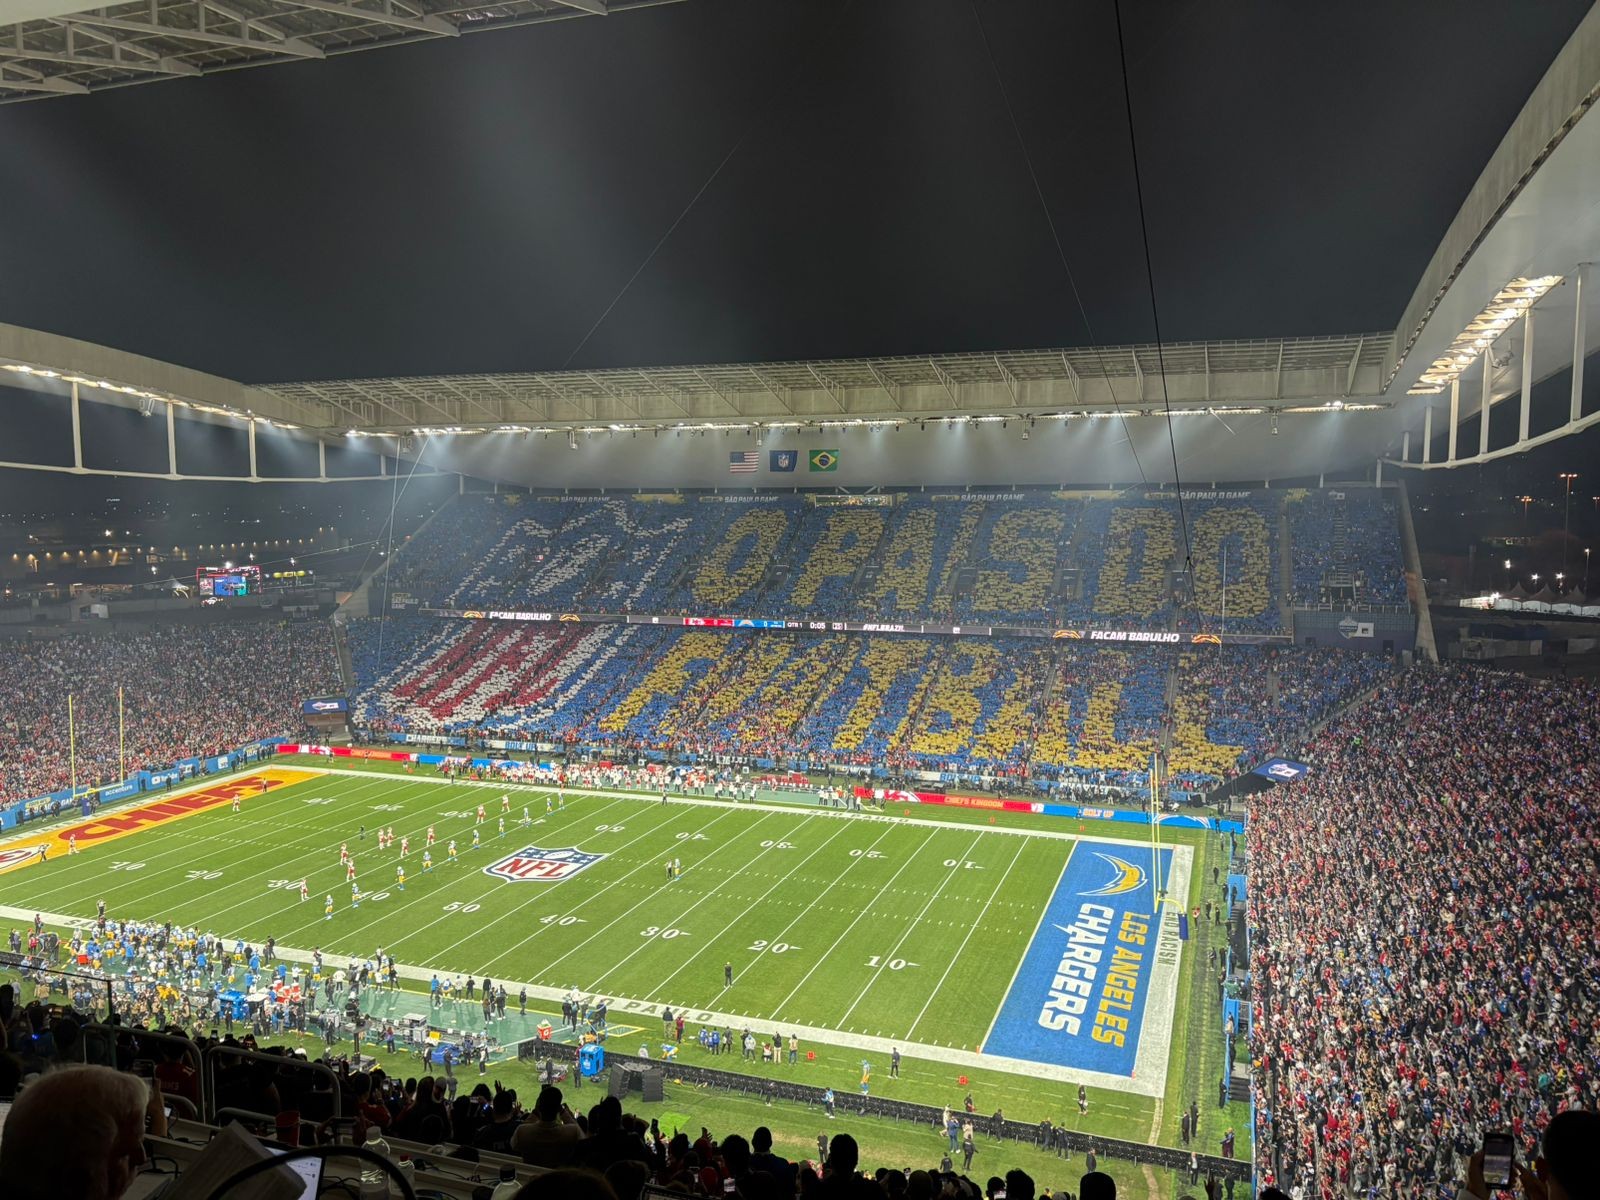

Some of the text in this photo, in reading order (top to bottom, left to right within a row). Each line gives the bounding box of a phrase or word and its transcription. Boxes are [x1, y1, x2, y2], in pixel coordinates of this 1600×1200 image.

[1128, 632, 1180, 642] BARULHO
[58, 776, 284, 841] CHIEFS
[971, 798, 1004, 807] KINGDOM
[500, 858, 567, 877] NFL
[442, 902, 480, 913] 50
[539, 915, 576, 926] 40
[640, 927, 682, 939] 30
[748, 940, 789, 953] 20
[1158, 931, 1178, 966] RACISM
[864, 955, 905, 970] 10
[1038, 903, 1114, 1036] CHARGERS
[1091, 910, 1150, 1048] LOS ANGELES
